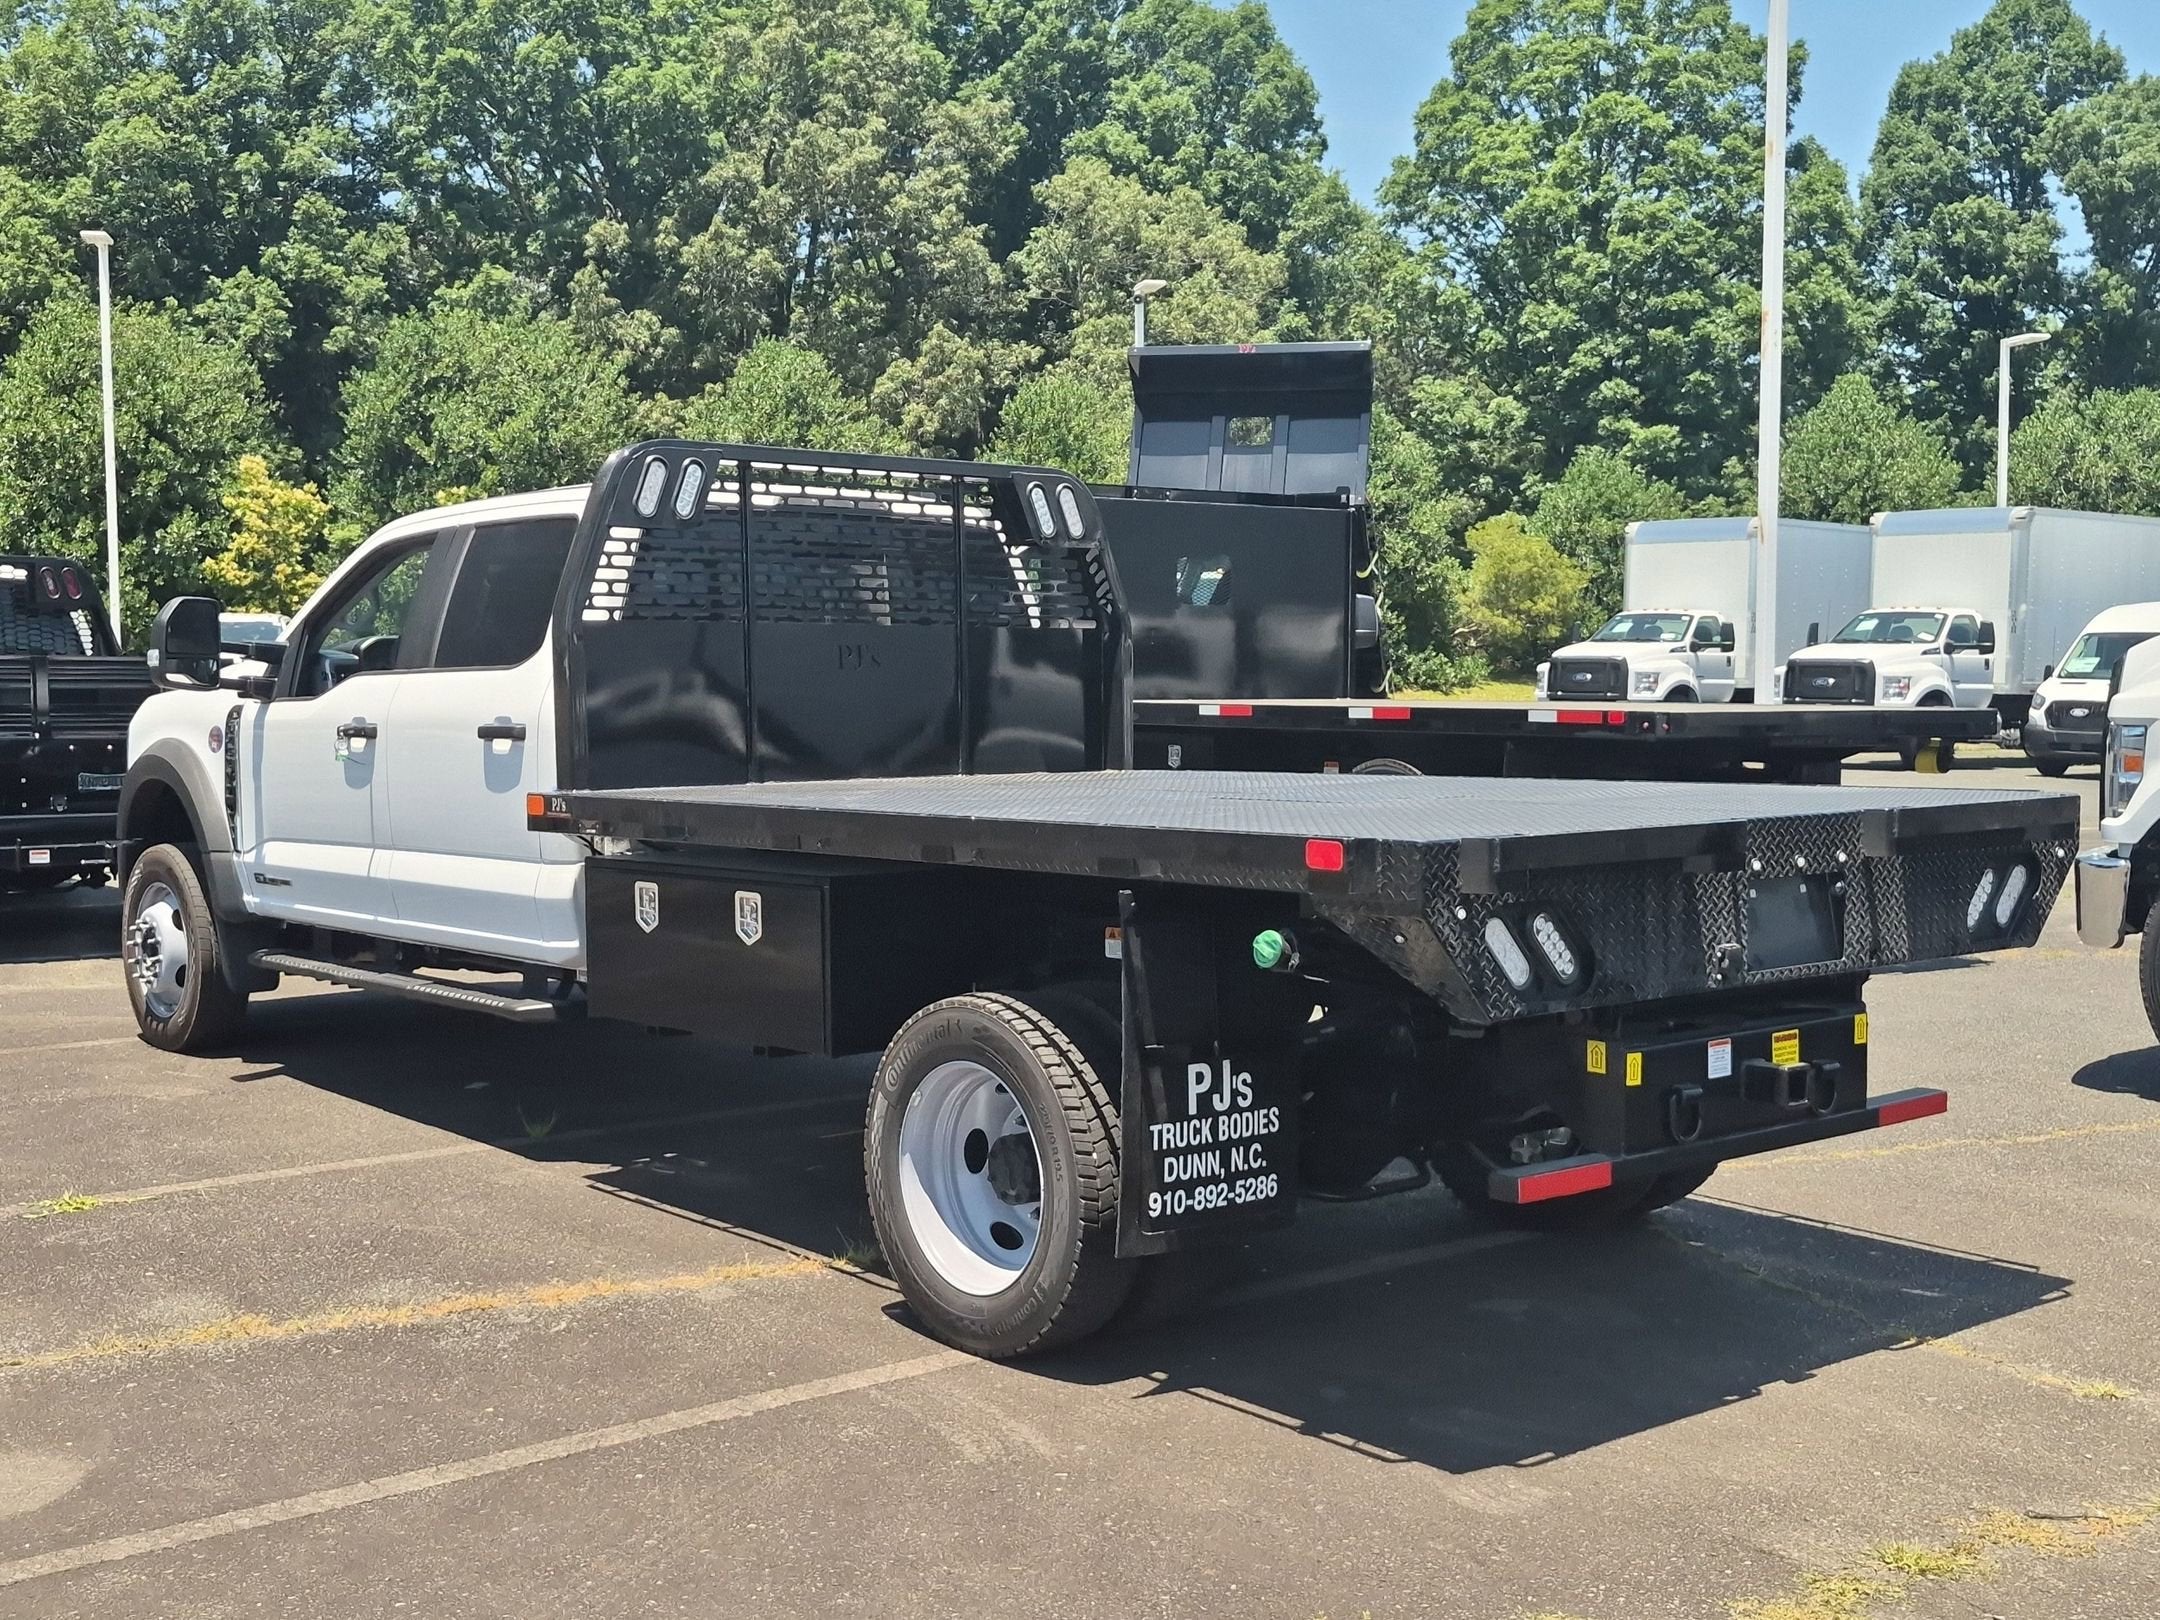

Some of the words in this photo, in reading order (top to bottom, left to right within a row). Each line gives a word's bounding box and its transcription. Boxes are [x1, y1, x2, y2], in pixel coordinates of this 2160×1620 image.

[1187, 1059, 1253, 1116] PJ's
[1149, 1117, 1213, 1151] TRUCK
[1218, 1106, 1280, 1141] BODIES
[1163, 1149, 1225, 1183] DUNN,
[1230, 1142, 1267, 1173] N.C.
[1148, 1173, 1278, 1218] 910-892-5286
